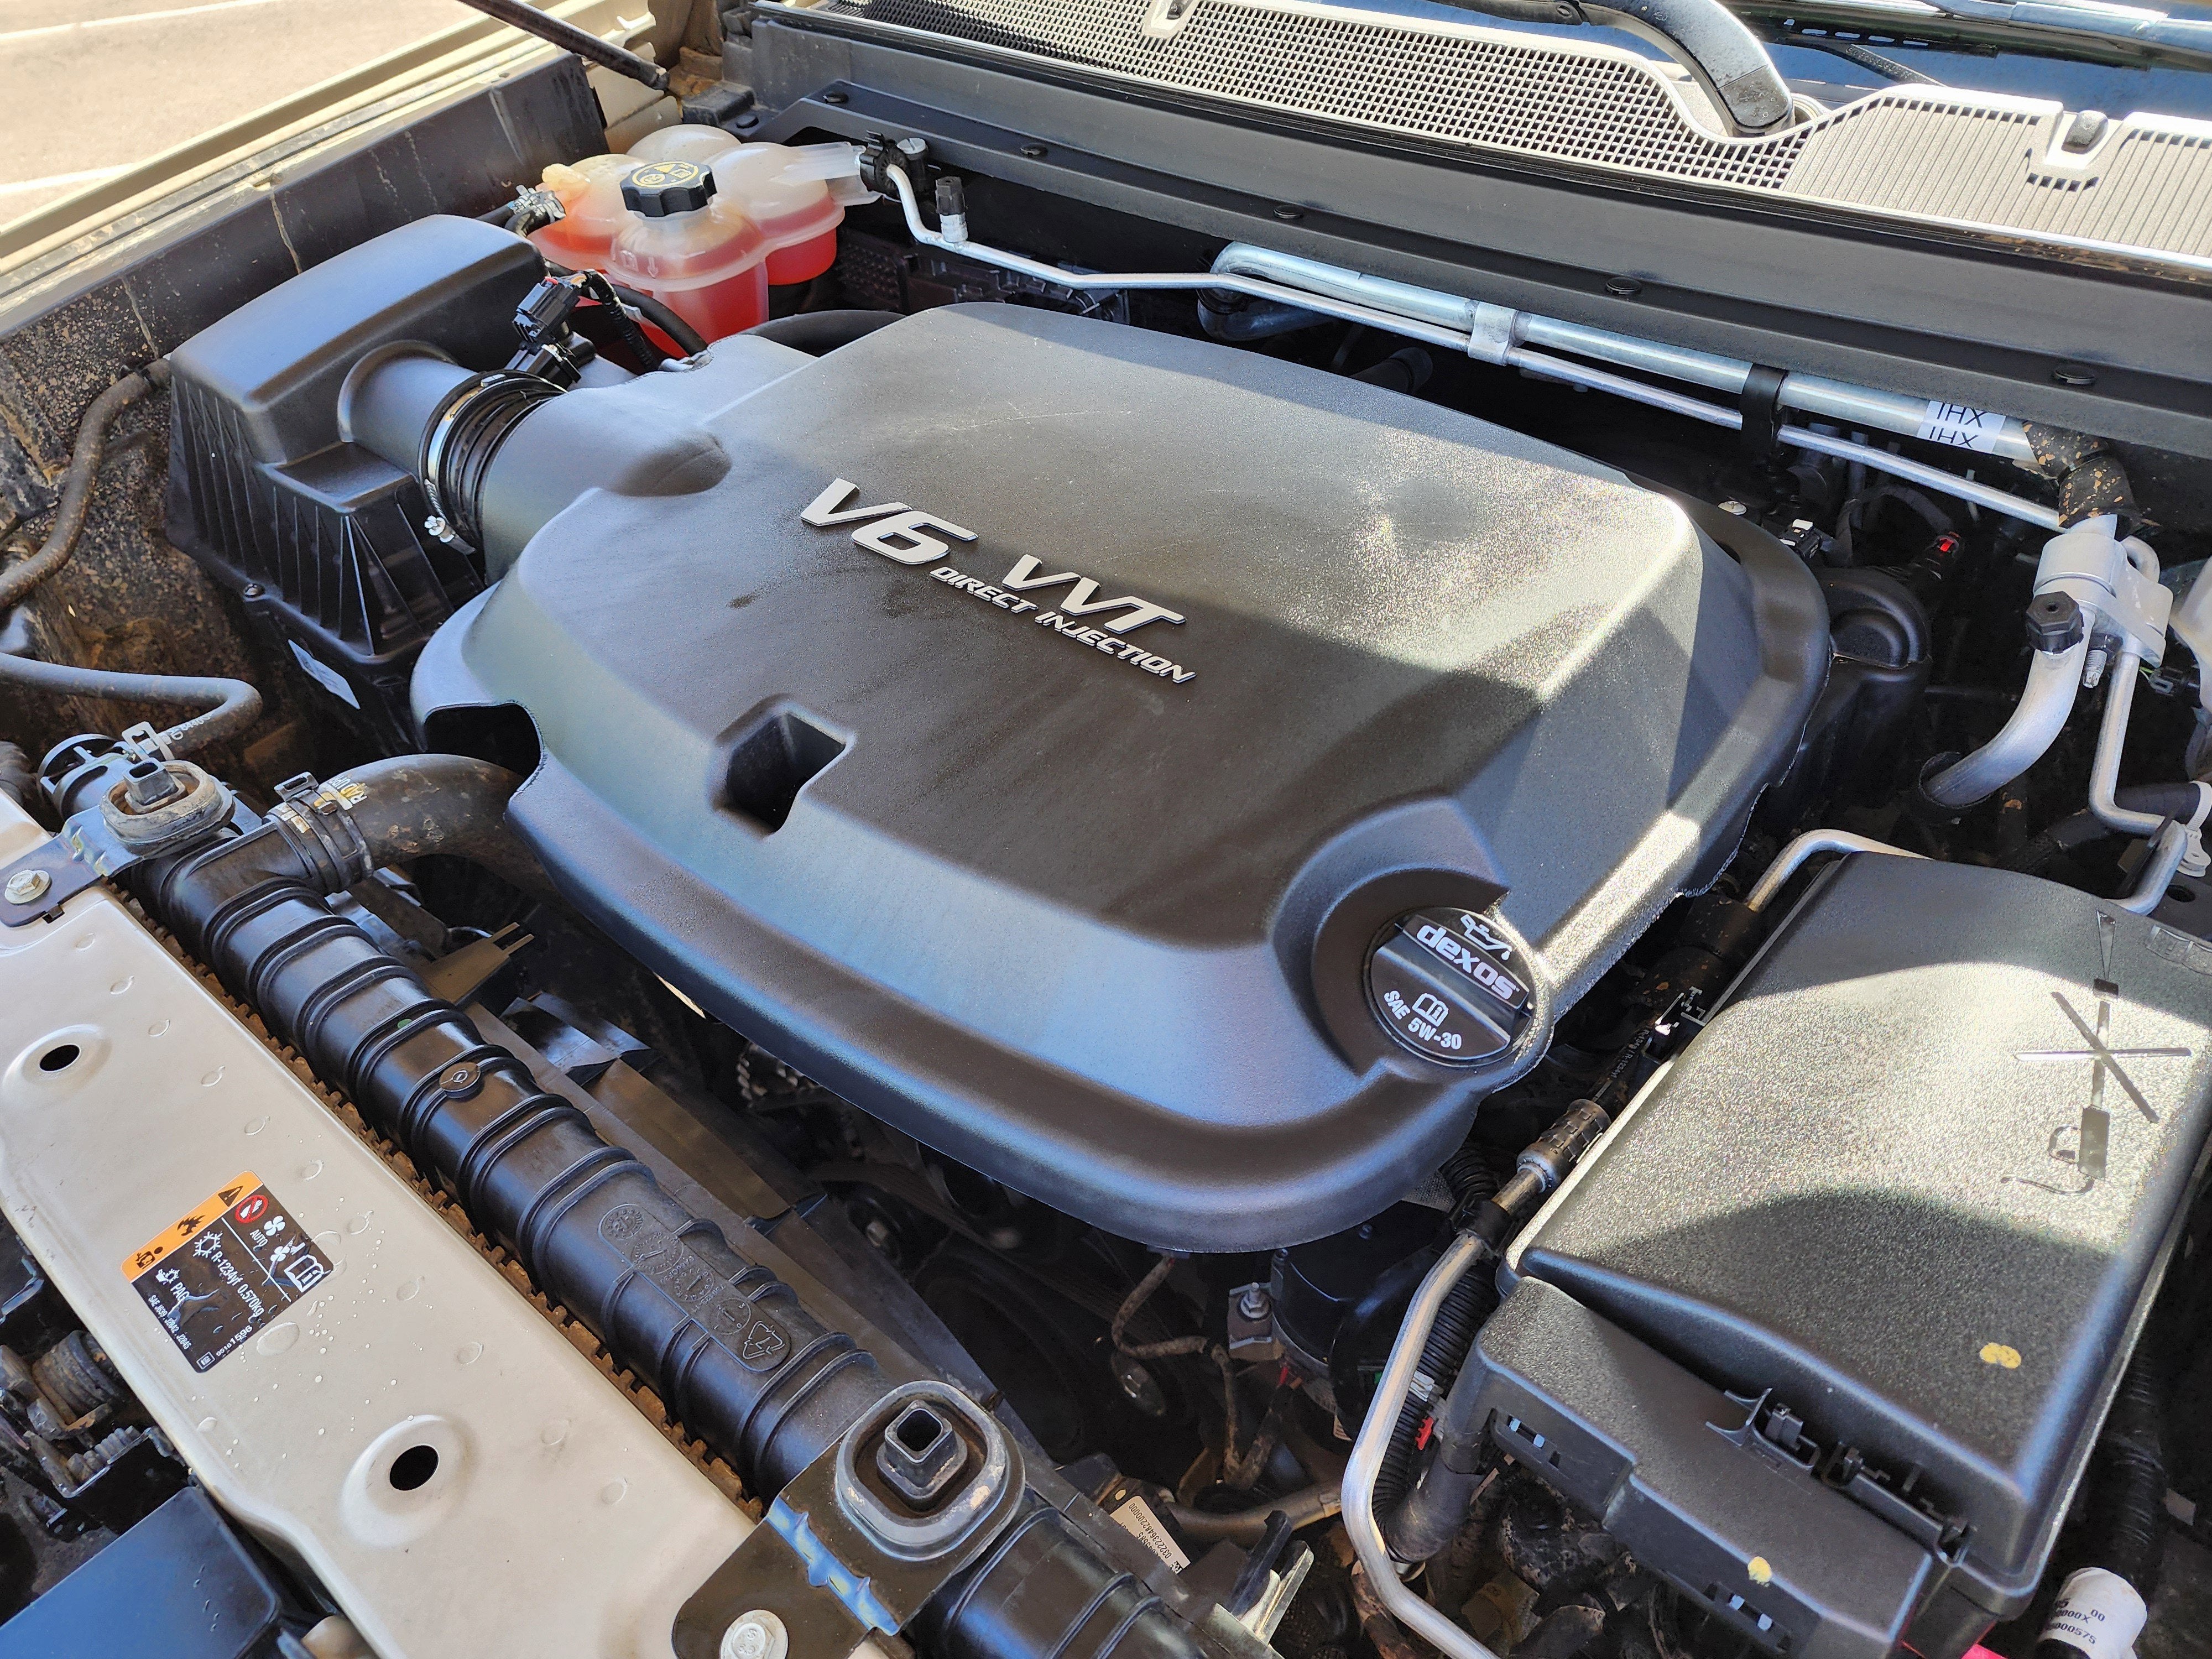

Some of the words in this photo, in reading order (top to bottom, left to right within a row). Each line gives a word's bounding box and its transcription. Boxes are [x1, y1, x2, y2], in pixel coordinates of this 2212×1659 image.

[800, 478, 979, 565] V6
[929, 566, 1040, 613] DIRECT
[1034, 611, 1198, 685] INJECTION
[1002, 554, 1187, 634] VVT
[1416, 925, 1514, 999] dexos
[1384, 990, 1411, 1020] SAE
[1408, 1018, 1463, 1050] 5W-30
[249, 1229, 269, 1247] AUTO
[148, 1295, 160, 1307] SAE
[170, 1281, 190, 1301] PAG
[211, 1250, 243, 1287] R-1234yf
[237, 1281, 265, 1317] 0.570kg
